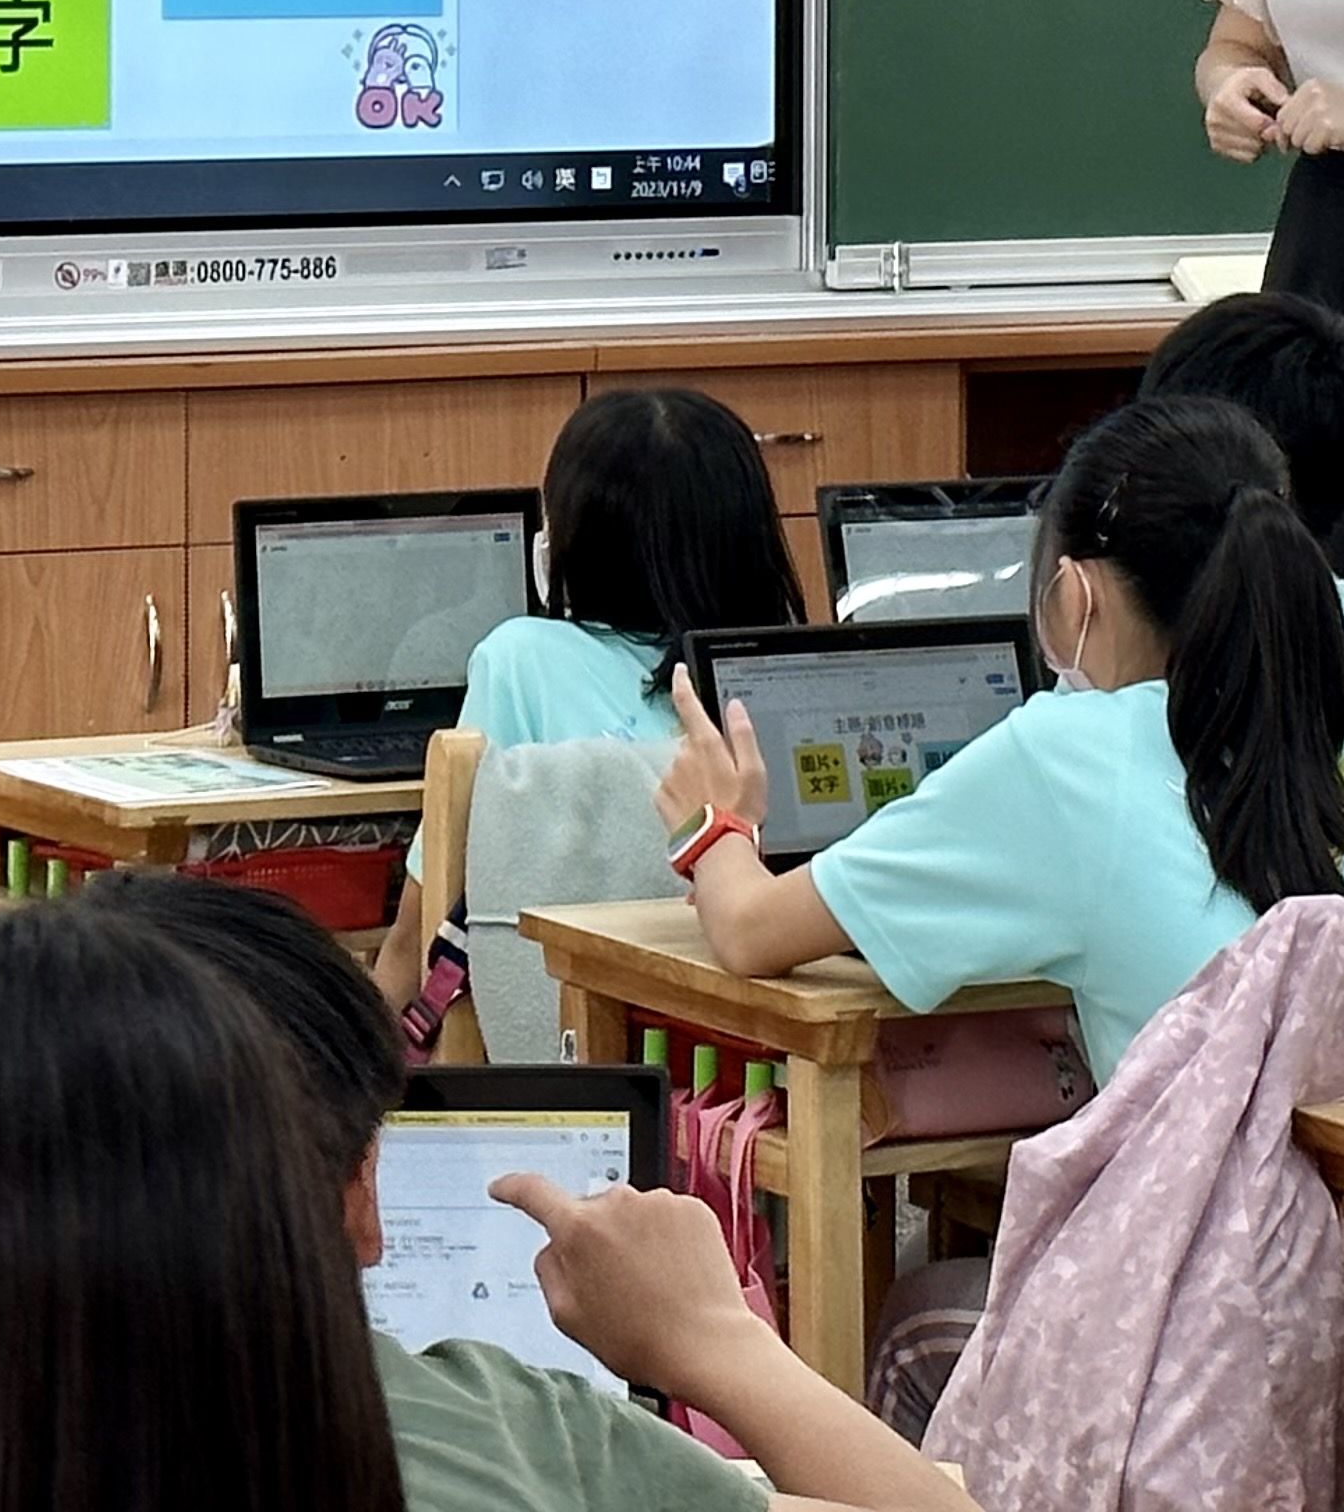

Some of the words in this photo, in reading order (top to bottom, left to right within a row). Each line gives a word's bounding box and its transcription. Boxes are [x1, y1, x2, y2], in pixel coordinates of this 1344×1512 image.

[355, 88, 443, 129] OK
[631, 180, 703, 198] 2023/11/9
[808, 775, 840, 794] 文字
